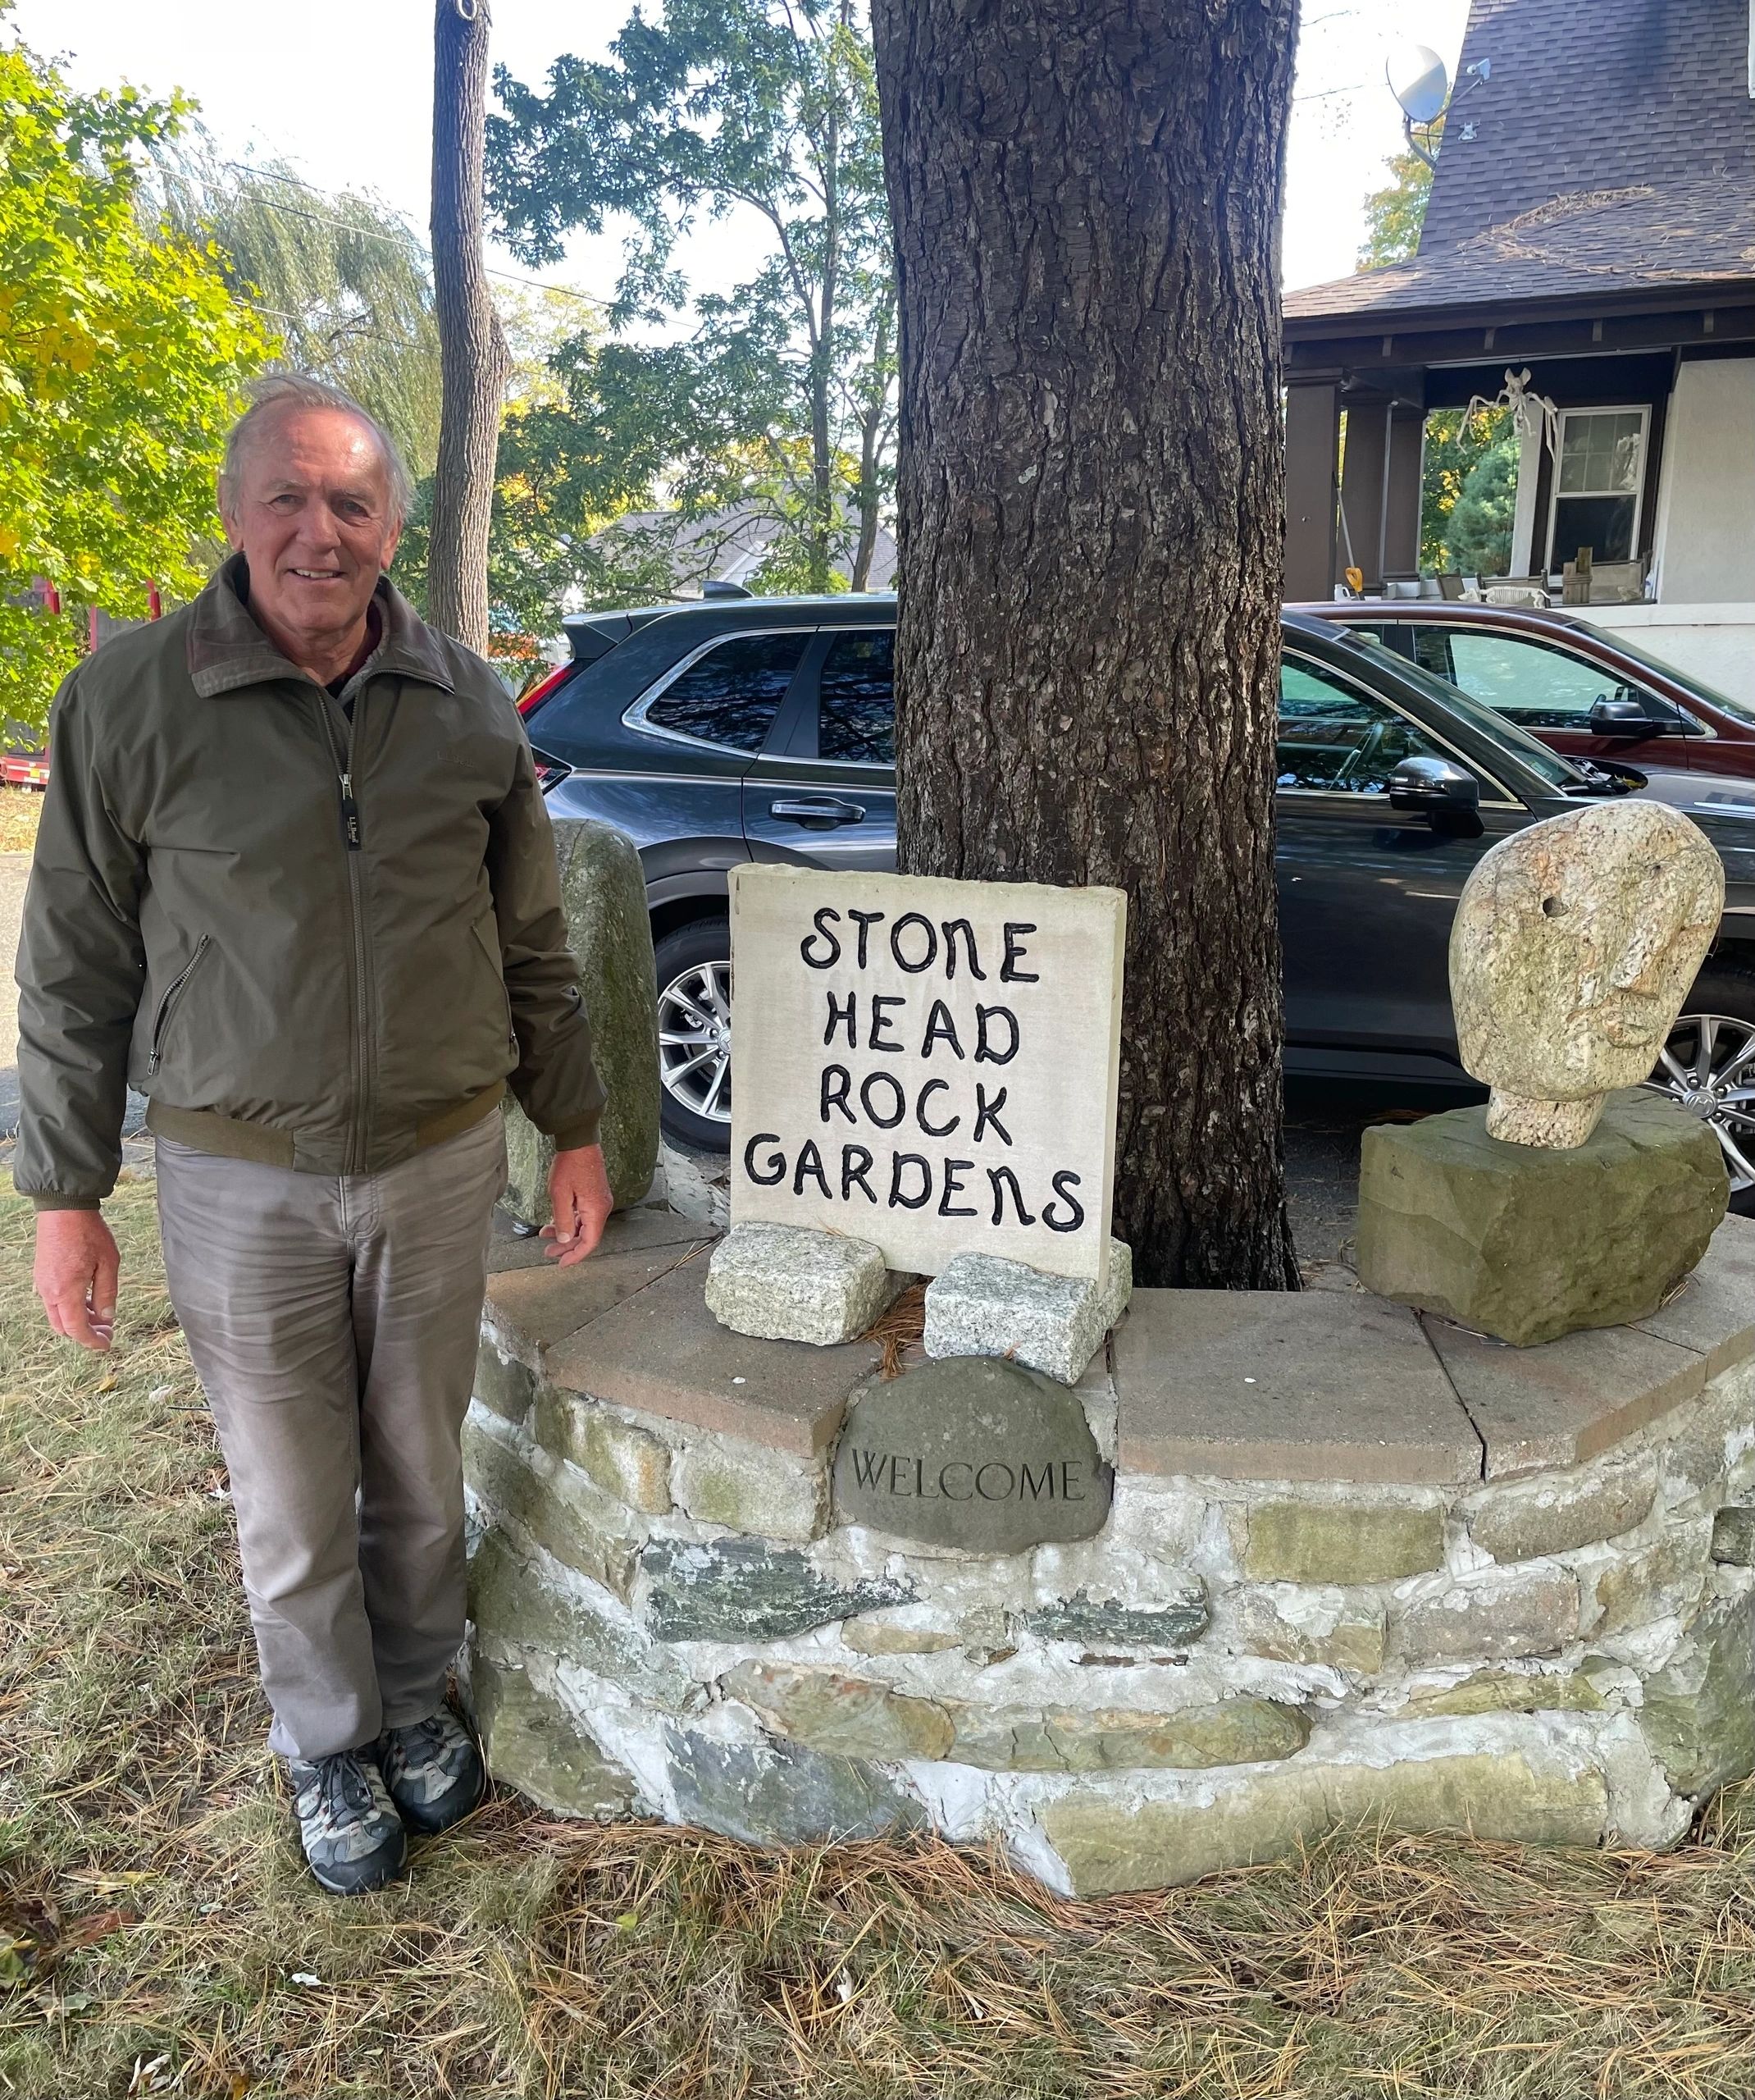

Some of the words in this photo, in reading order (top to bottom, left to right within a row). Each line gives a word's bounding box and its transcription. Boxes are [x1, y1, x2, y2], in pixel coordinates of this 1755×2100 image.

[800, 908, 1039, 982] STONE
[823, 991, 1019, 1065] HEAD
[820, 1064, 1013, 1146] ROCK
[744, 1133, 1085, 1233] GARDENS
[851, 1449, 1086, 1502] WELCOME
